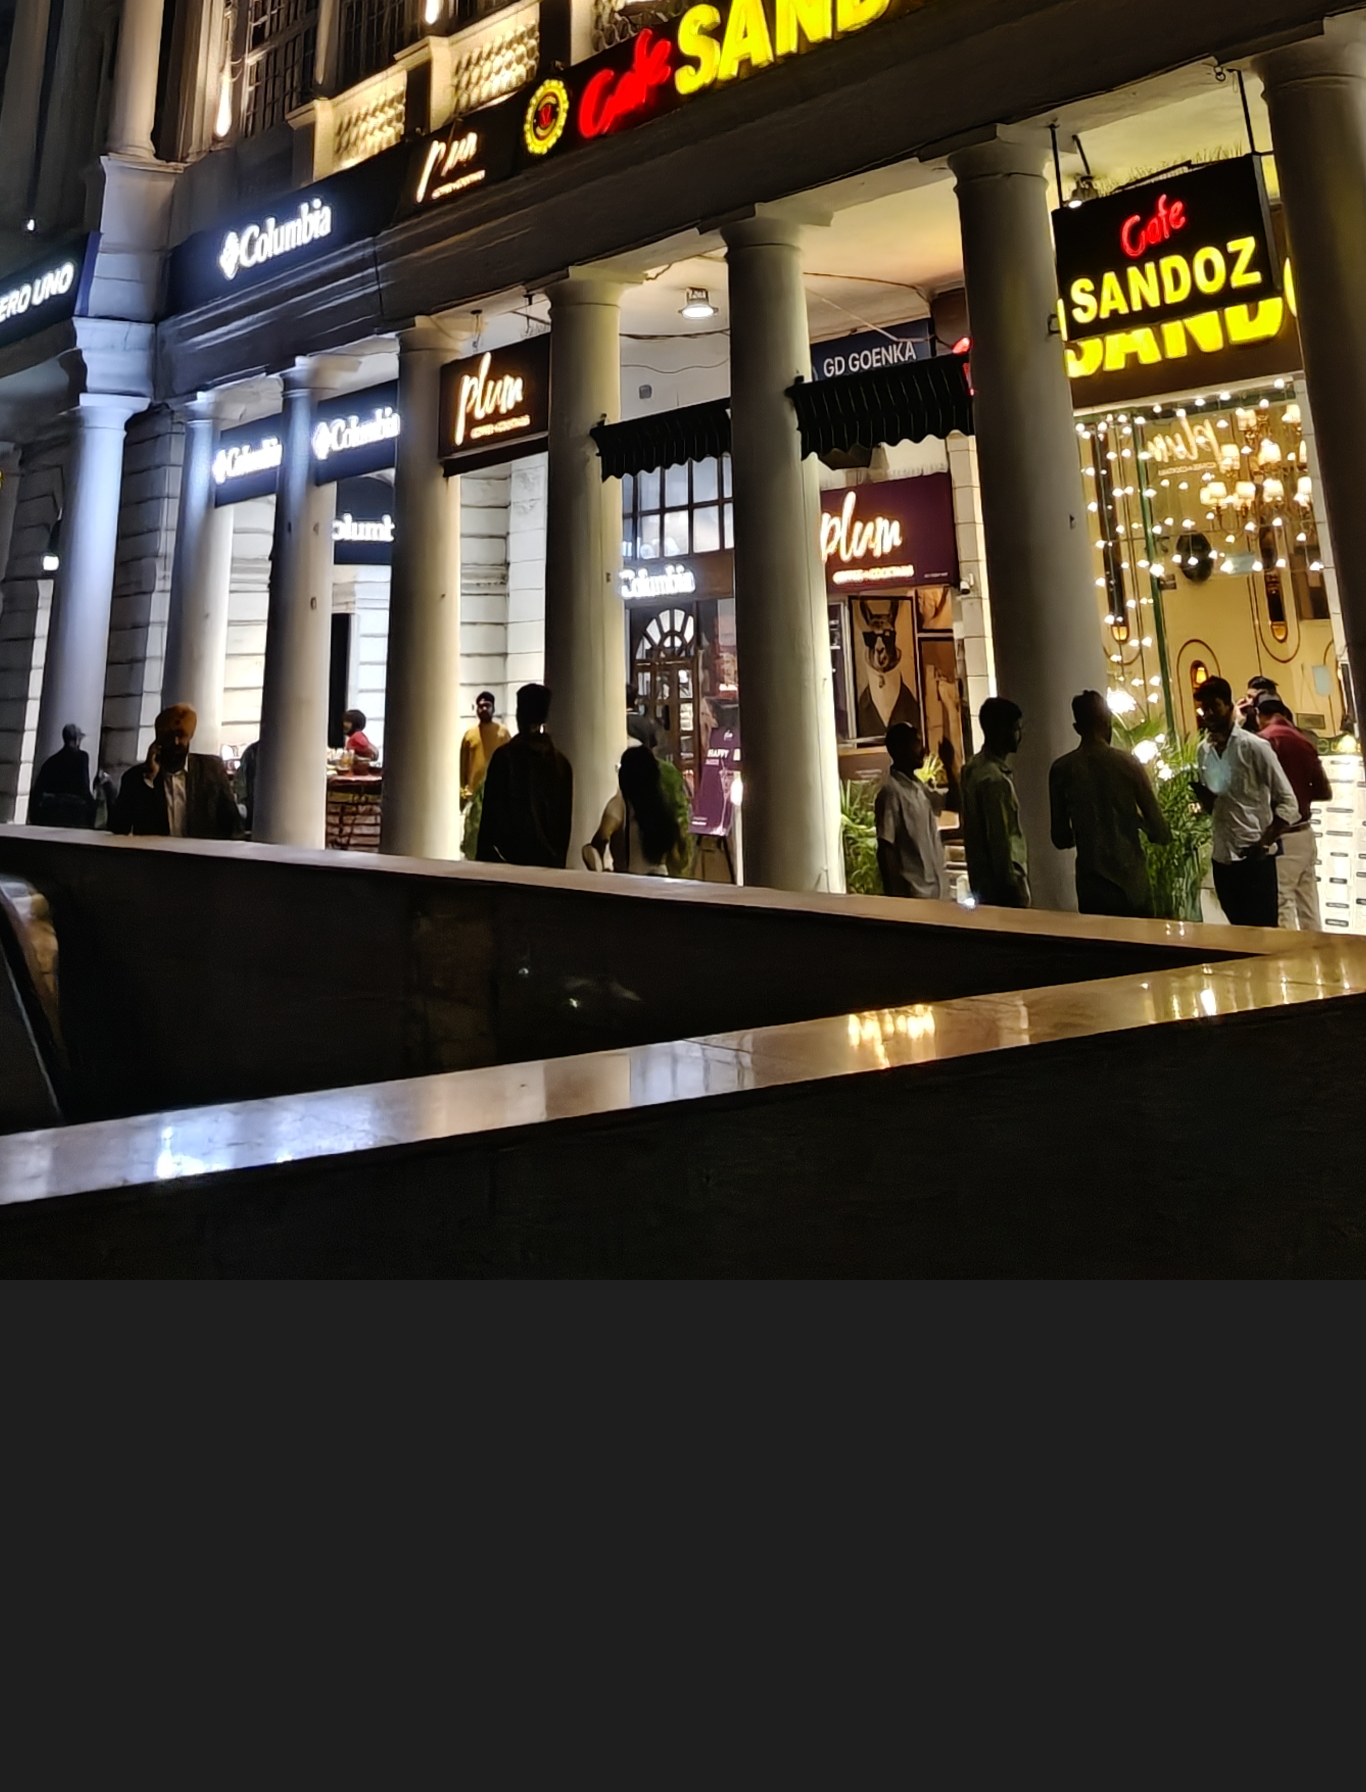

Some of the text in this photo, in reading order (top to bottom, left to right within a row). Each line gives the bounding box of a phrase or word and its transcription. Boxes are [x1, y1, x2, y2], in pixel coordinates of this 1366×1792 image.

[578, 28, 672, 139] Cafe
[239, 199, 333, 268] Columbia
[1121, 194, 1186, 257] Cafe
[32, 262, 76, 306] UNO
[1070, 236, 1263, 324] SANDOZ
[823, 340, 916, 377] GD GOENKA
[332, 407, 401, 451] Columbia
[455, 351, 524, 446] plum
[820, 491, 903, 563] plum
